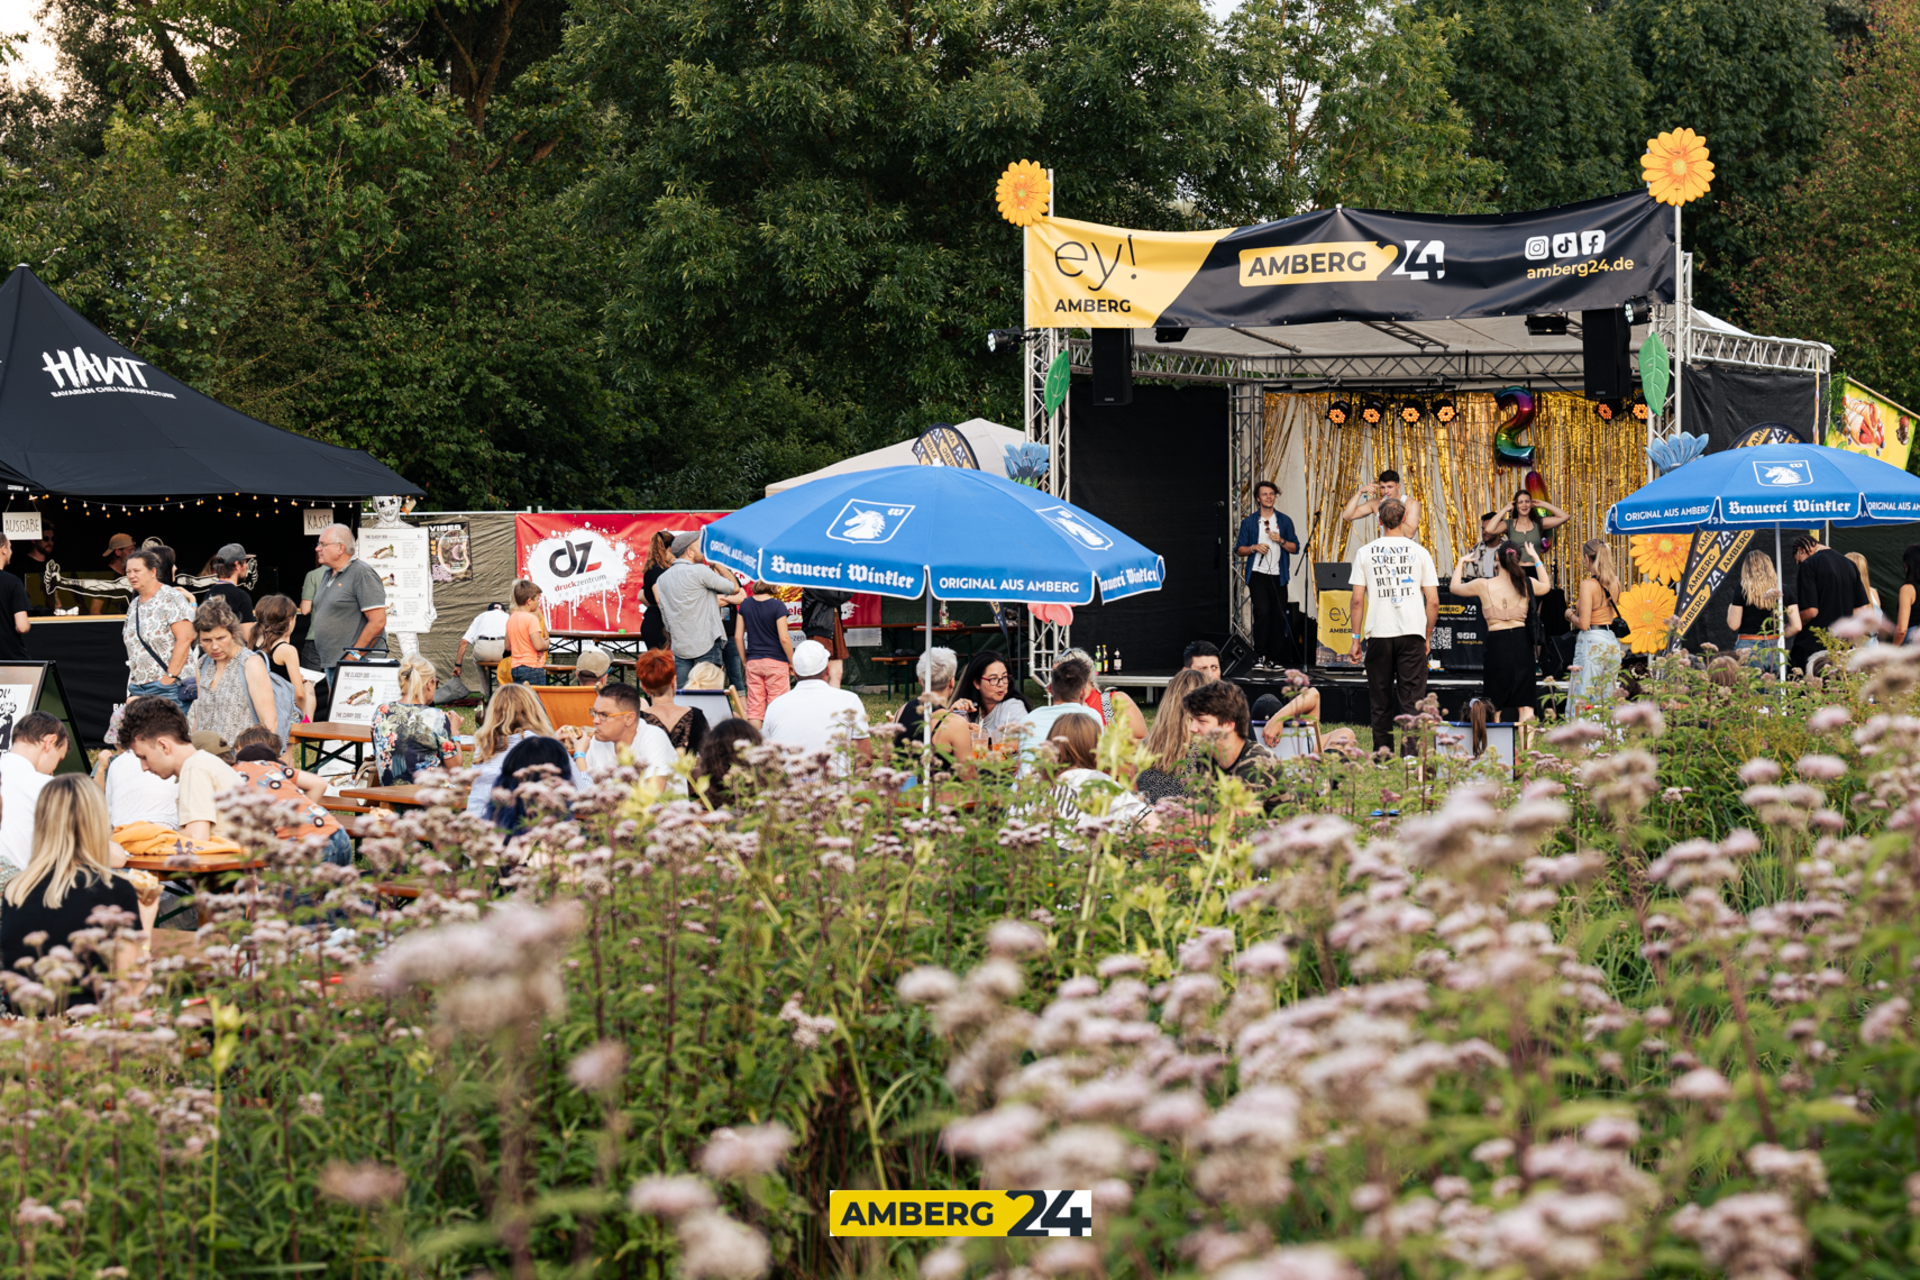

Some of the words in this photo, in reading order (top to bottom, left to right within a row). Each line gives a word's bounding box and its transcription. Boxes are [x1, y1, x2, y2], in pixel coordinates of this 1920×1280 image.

[1055, 234, 1137, 291] ey!
[1248, 251, 1367, 277] AMBERG
[1526, 257, 1635, 280] amberg24.de
[1054, 298, 1132, 313] AMBERG
[42, 346, 148, 389] HAWT
[50, 387, 96, 398] BAVARIAN
[1494, 385, 1535, 467] 2
[1624, 509, 1661, 521] ORIGINAL
[1663, 507, 1680, 518] AUS
[1680, 504, 1710, 516] AMBERG
[1728, 500, 1788, 515] Brauerei
[1792, 499, 1851, 513] Winkler
[1867, 501, 1897, 511] ORIGINAL
[1898, 501, 1911, 511] AUS
[5, 519, 40, 533] AUSGABE
[429, 524, 461, 532] VIBES
[710, 540, 731, 557] ORIGINAL
[1389, 546, 1411, 555] NOT
[1723, 531, 1752, 570] AMBERG
[1371, 555, 1396, 565] SURE
[1399, 555, 1409, 564] IF
[770, 554, 843, 579] Brauerei
[847, 563, 915, 589] Winkler
[1373, 565, 1391, 576] IT'S
[1396, 566, 1414, 575] ART
[1688, 553, 1716, 592] AMBERG
[554, 574, 607, 592] druckzentrum
[939, 577, 997, 590] ORIGINAL
[999, 579, 1024, 591] AUS
[1026, 580, 1080, 594] AMBERG
[1098, 570, 1127, 592] rauerei
[1376, 576, 1394, 587] BUT
